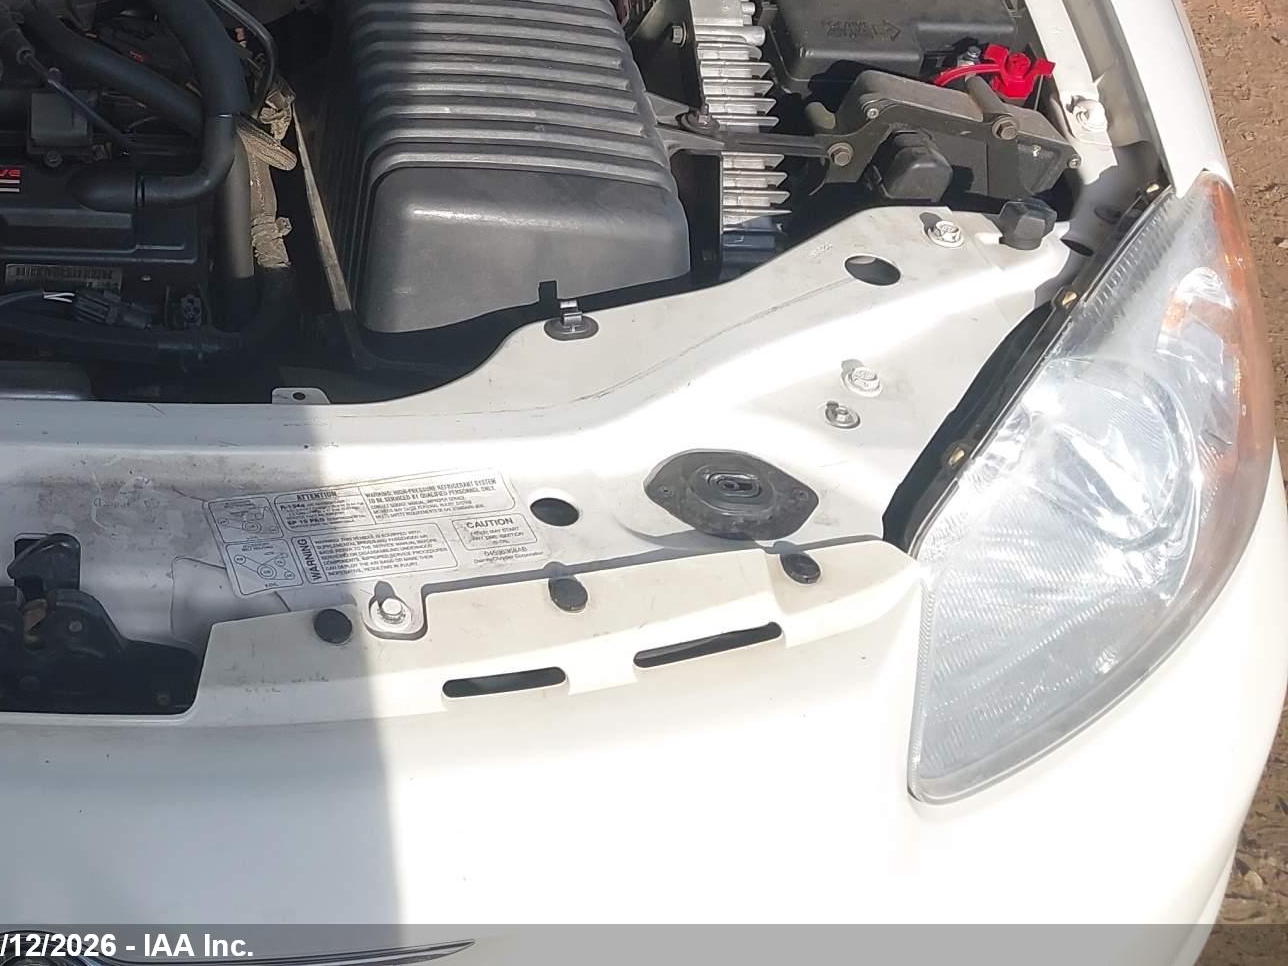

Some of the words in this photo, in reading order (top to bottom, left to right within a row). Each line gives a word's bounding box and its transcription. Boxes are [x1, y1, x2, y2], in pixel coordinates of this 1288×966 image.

[296, 491, 337, 501] ATTENTION
[466, 518, 513, 528] CAUTION
[297, 538, 322, 581] WARNING
